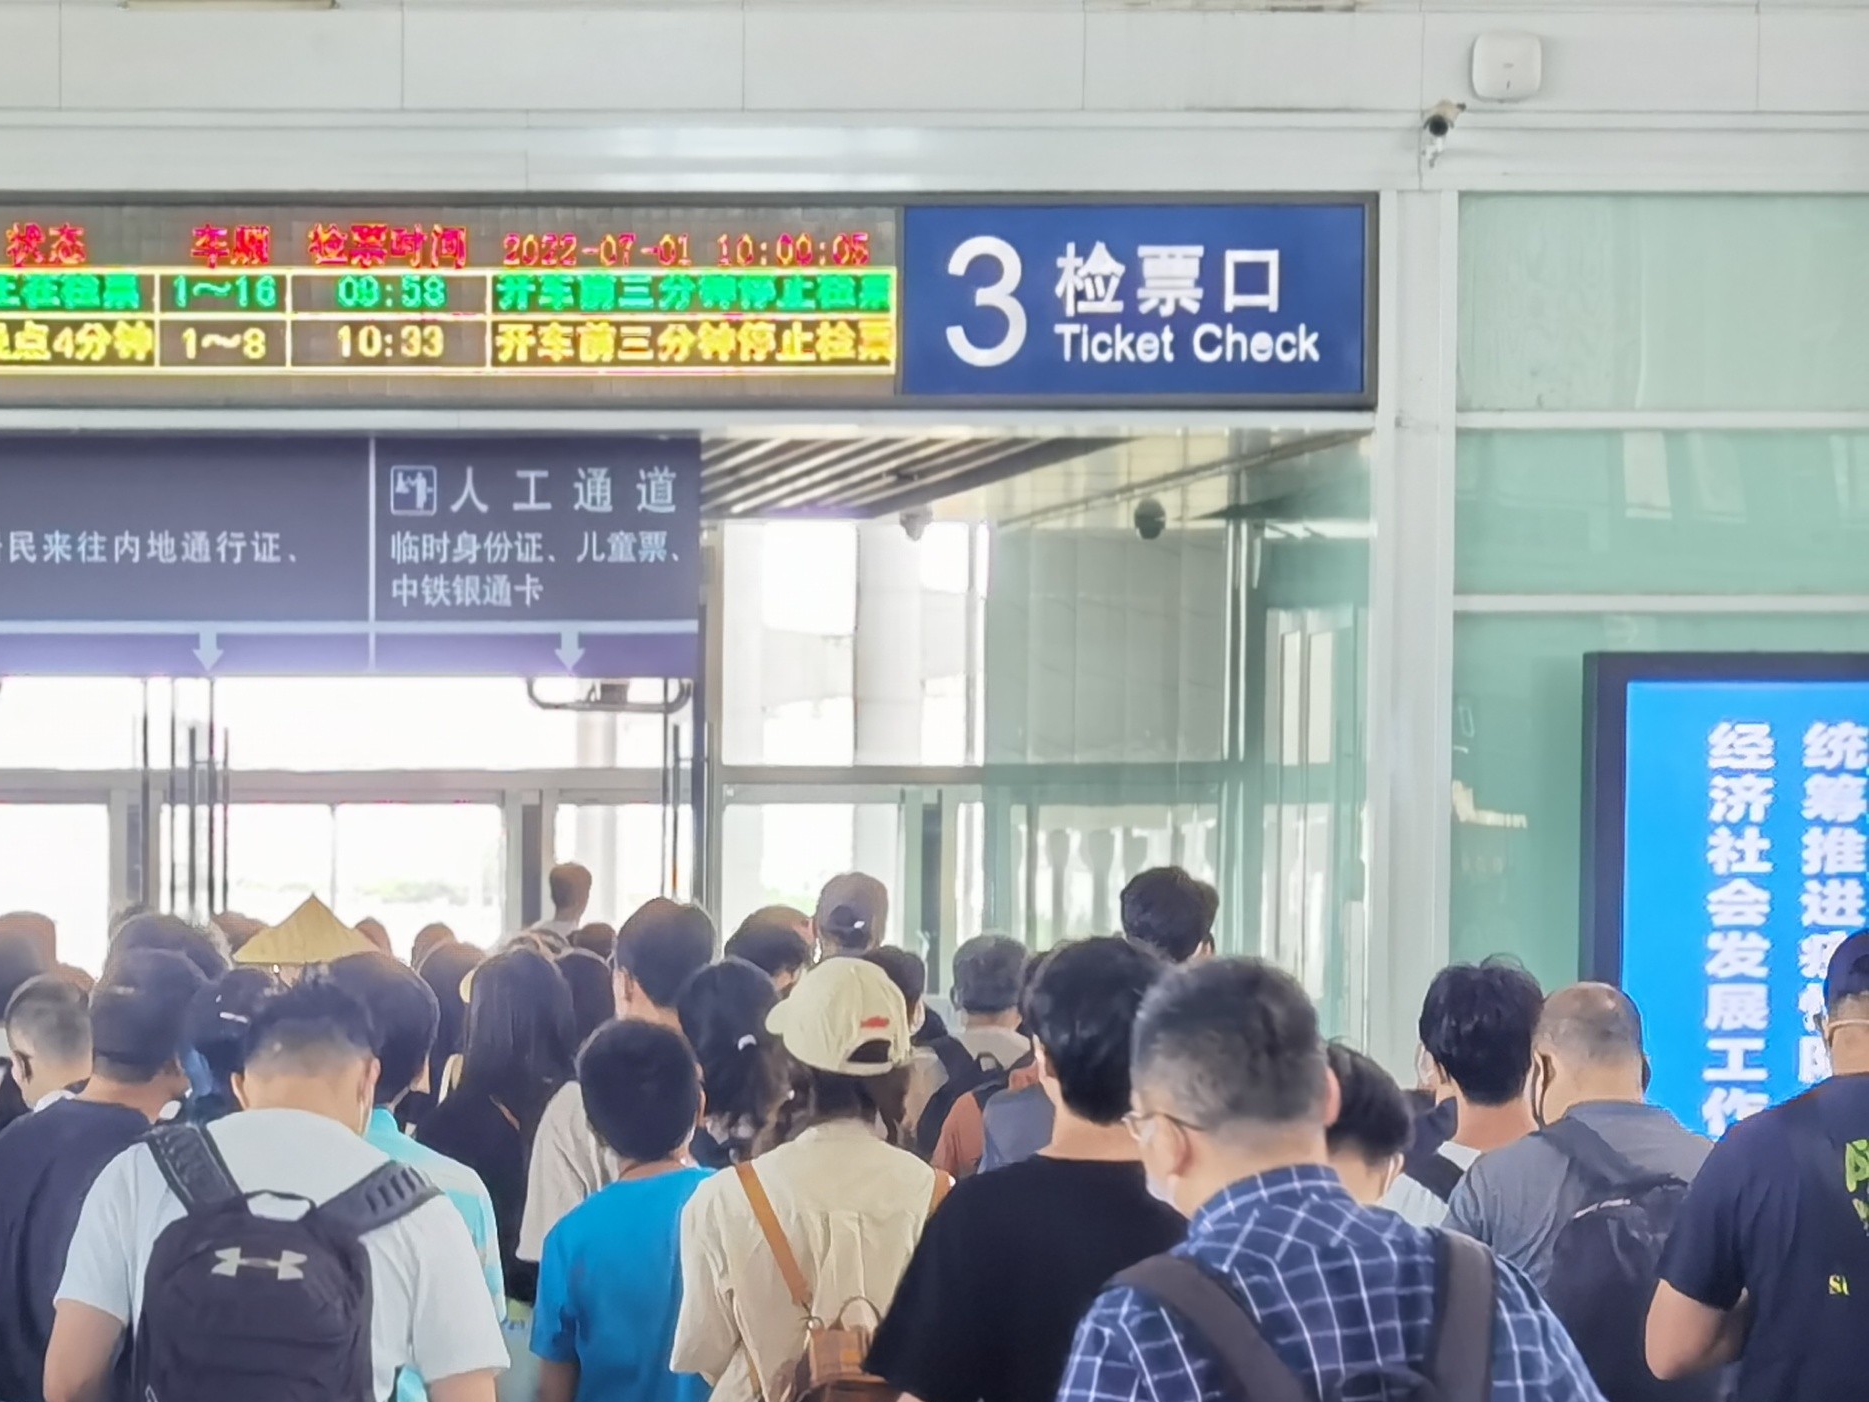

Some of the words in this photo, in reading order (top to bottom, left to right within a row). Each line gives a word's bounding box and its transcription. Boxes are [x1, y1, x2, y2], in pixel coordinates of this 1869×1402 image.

[6, 223, 86, 267] 状态
[191, 223, 271, 267] 车厢
[308, 224, 468, 269] 检票时间
[503, 233, 691, 266] 2022-07-01
[1054, 240, 1281, 316] 检票口
[946, 235, 1027, 366] 3
[496, 321, 891, 362] 开车前三分钟停止检票
[1055, 325, 1174, 362] Ticket
[1192, 324, 1320, 362] Check
[451, 467, 677, 514] 人工通道
[391, 573, 543, 609] 中铁银通卡
[1703, 721, 1776, 1137] 经济社会发展工作
